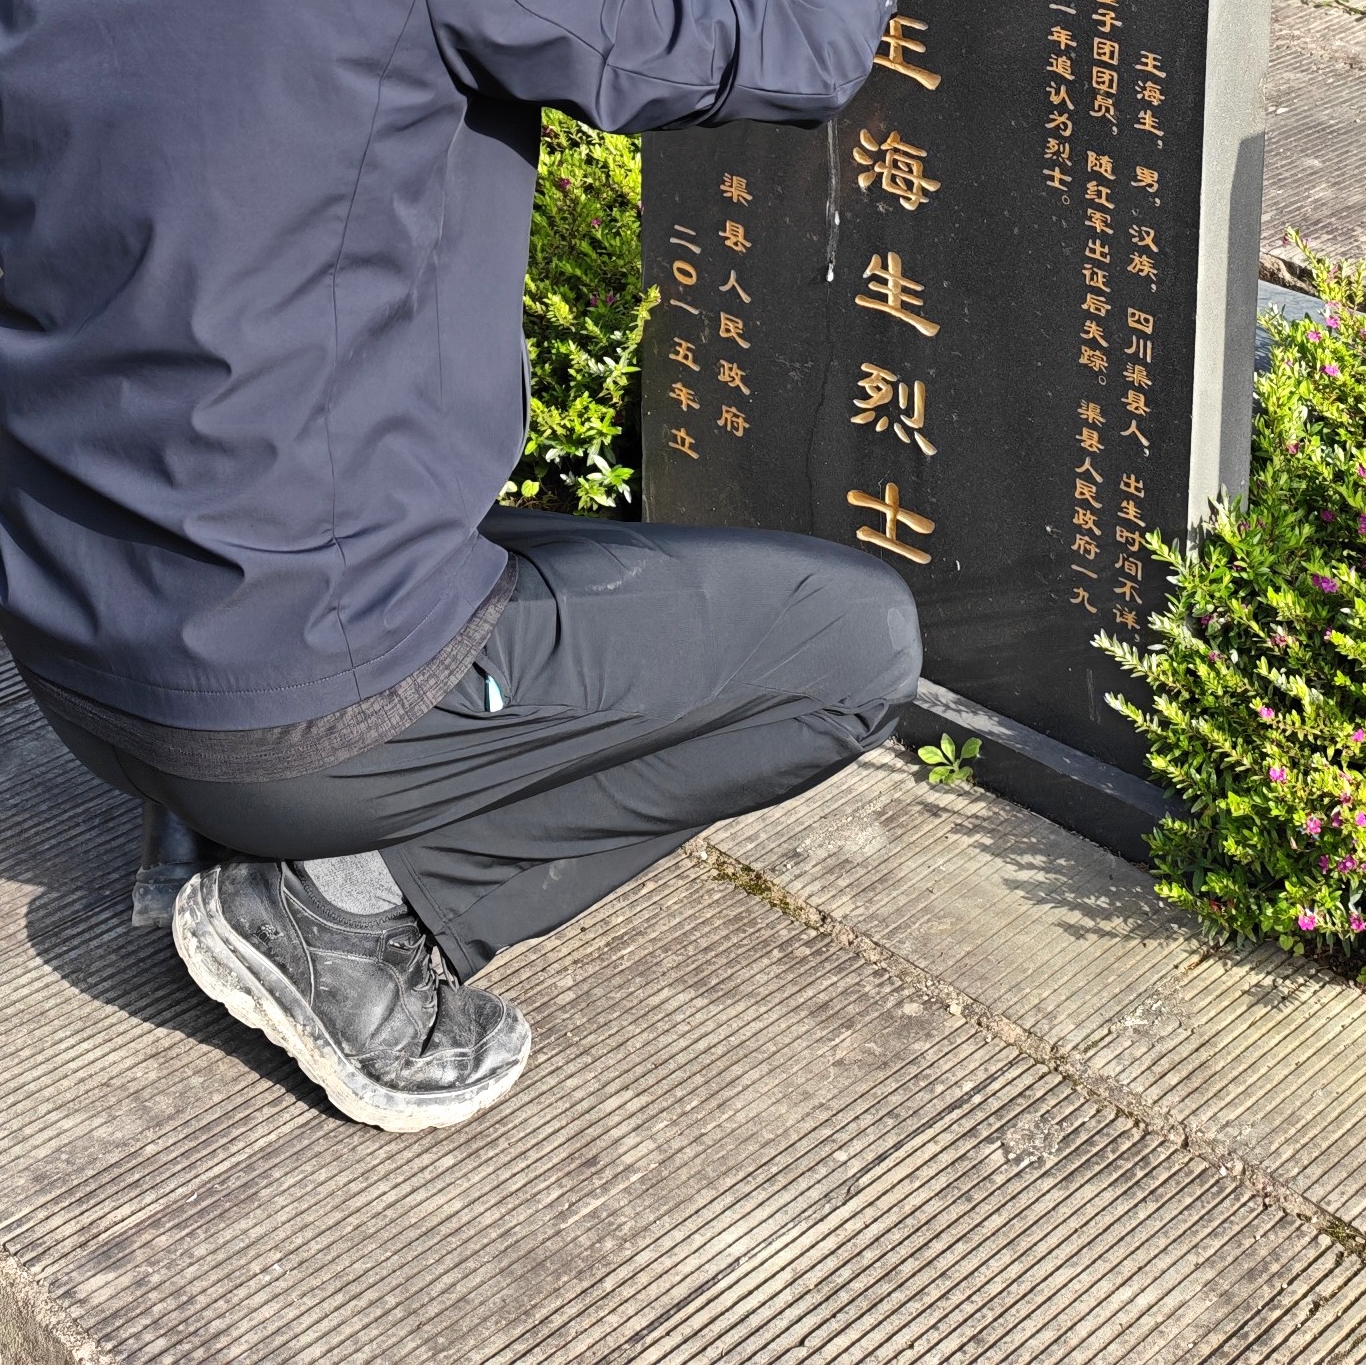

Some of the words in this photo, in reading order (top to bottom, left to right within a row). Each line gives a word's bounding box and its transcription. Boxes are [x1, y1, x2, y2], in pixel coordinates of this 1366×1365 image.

[717, 173, 752, 438] 渠县人民政府
[847, 14, 941, 564] 王海生烈士
